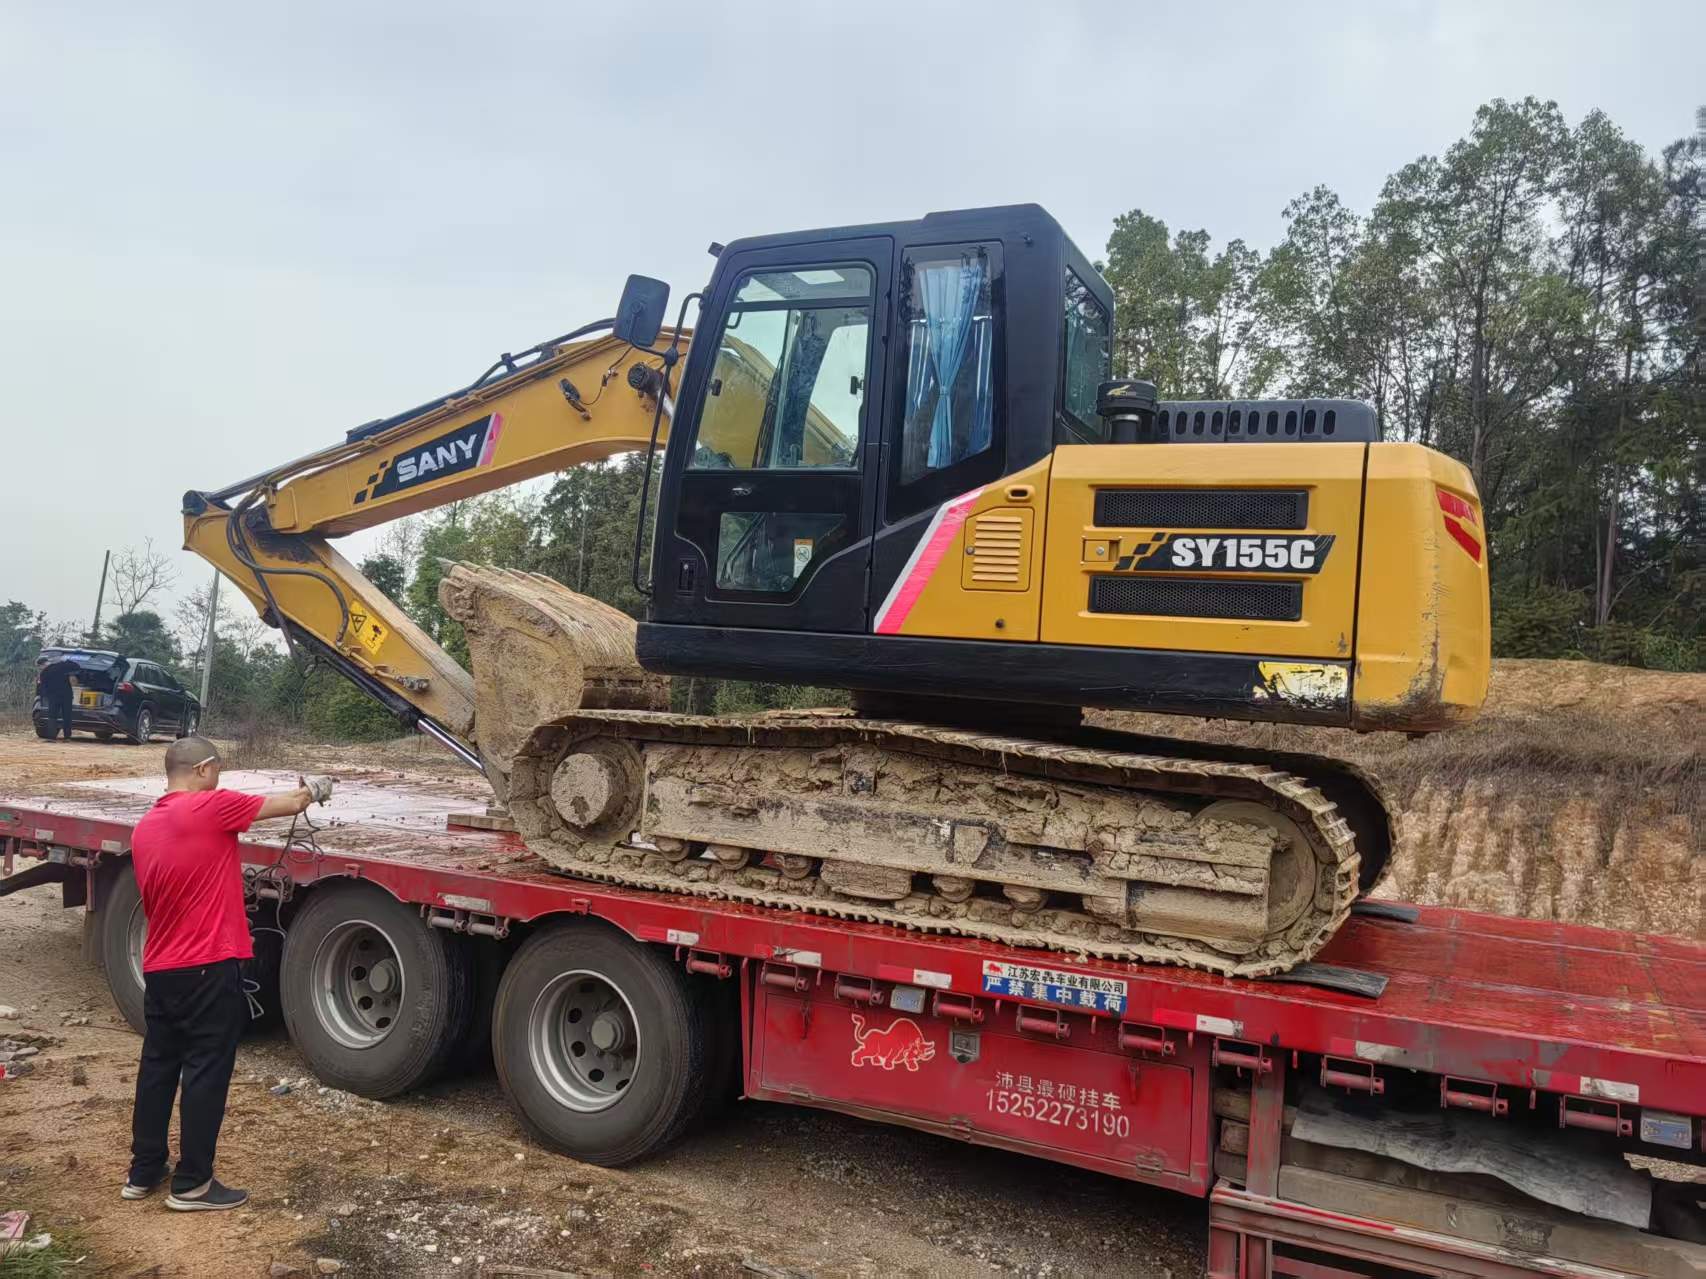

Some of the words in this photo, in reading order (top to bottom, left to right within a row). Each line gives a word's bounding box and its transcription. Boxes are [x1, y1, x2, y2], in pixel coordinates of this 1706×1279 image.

[397, 434, 477, 483] SANY
[1171, 538, 1316, 569] SY155C
[985, 975, 1122, 1012] 严禁集中载荷
[996, 1071, 1121, 1111] 沛县最硬挂车
[986, 1088, 1130, 1137] 15252273190
